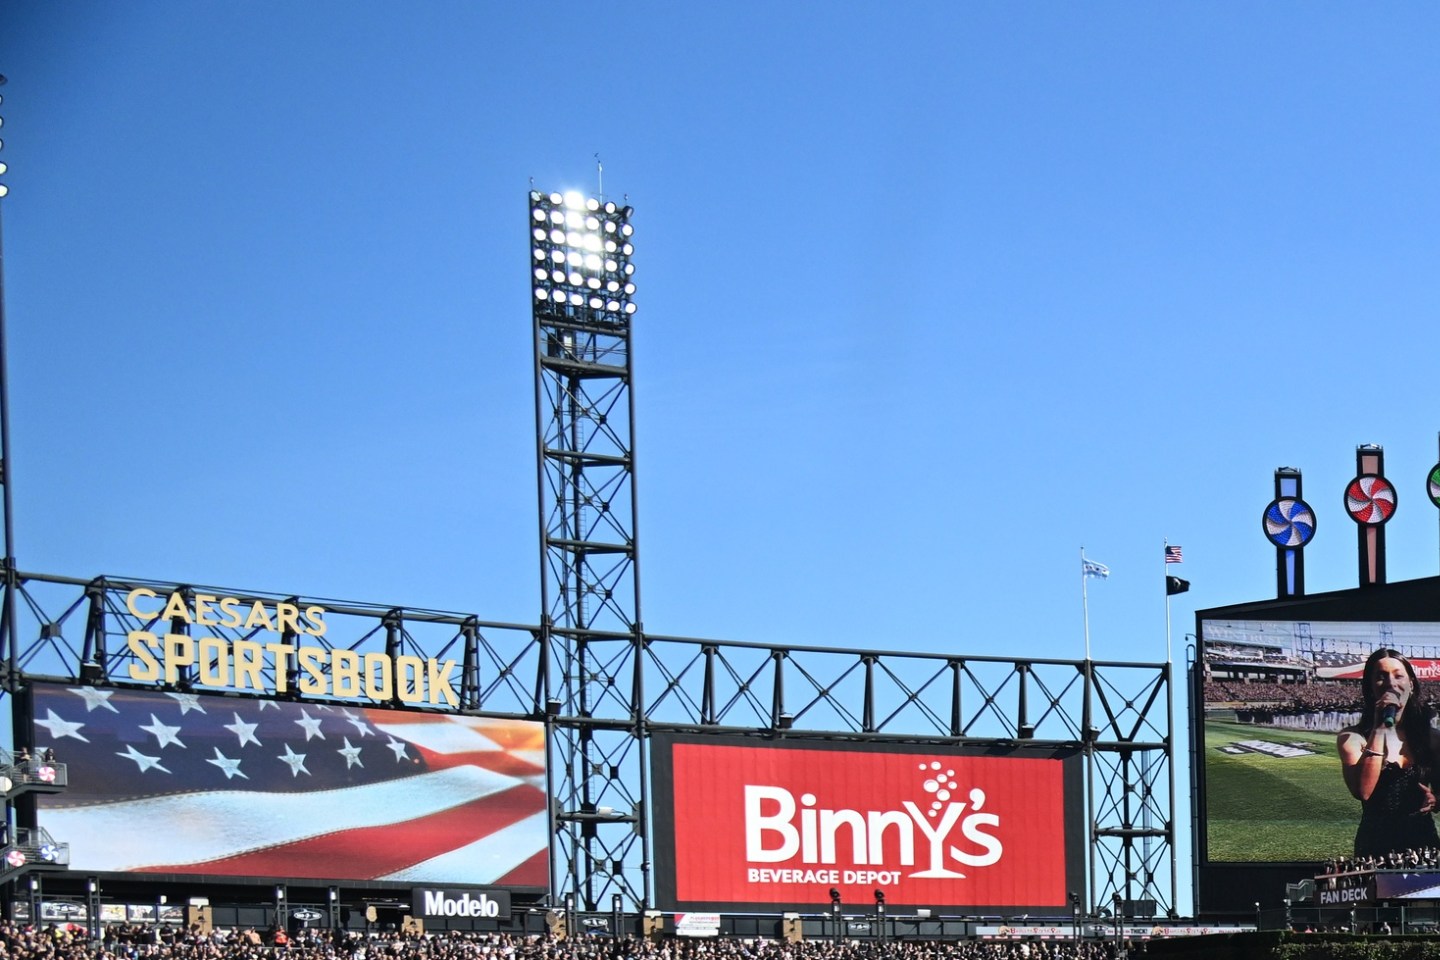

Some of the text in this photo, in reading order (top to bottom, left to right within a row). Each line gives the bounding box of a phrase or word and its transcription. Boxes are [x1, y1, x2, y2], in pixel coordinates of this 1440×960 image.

[126, 588, 328, 637] CAESARS
[127, 630, 461, 708] SPORTSBOOK
[744, 785, 1003, 879] Binny's
[748, 868, 902, 885] BEVERAGE DEPOT
[1320, 887, 1368, 904] FAN DECK
[424, 890, 500, 918] Modelo
